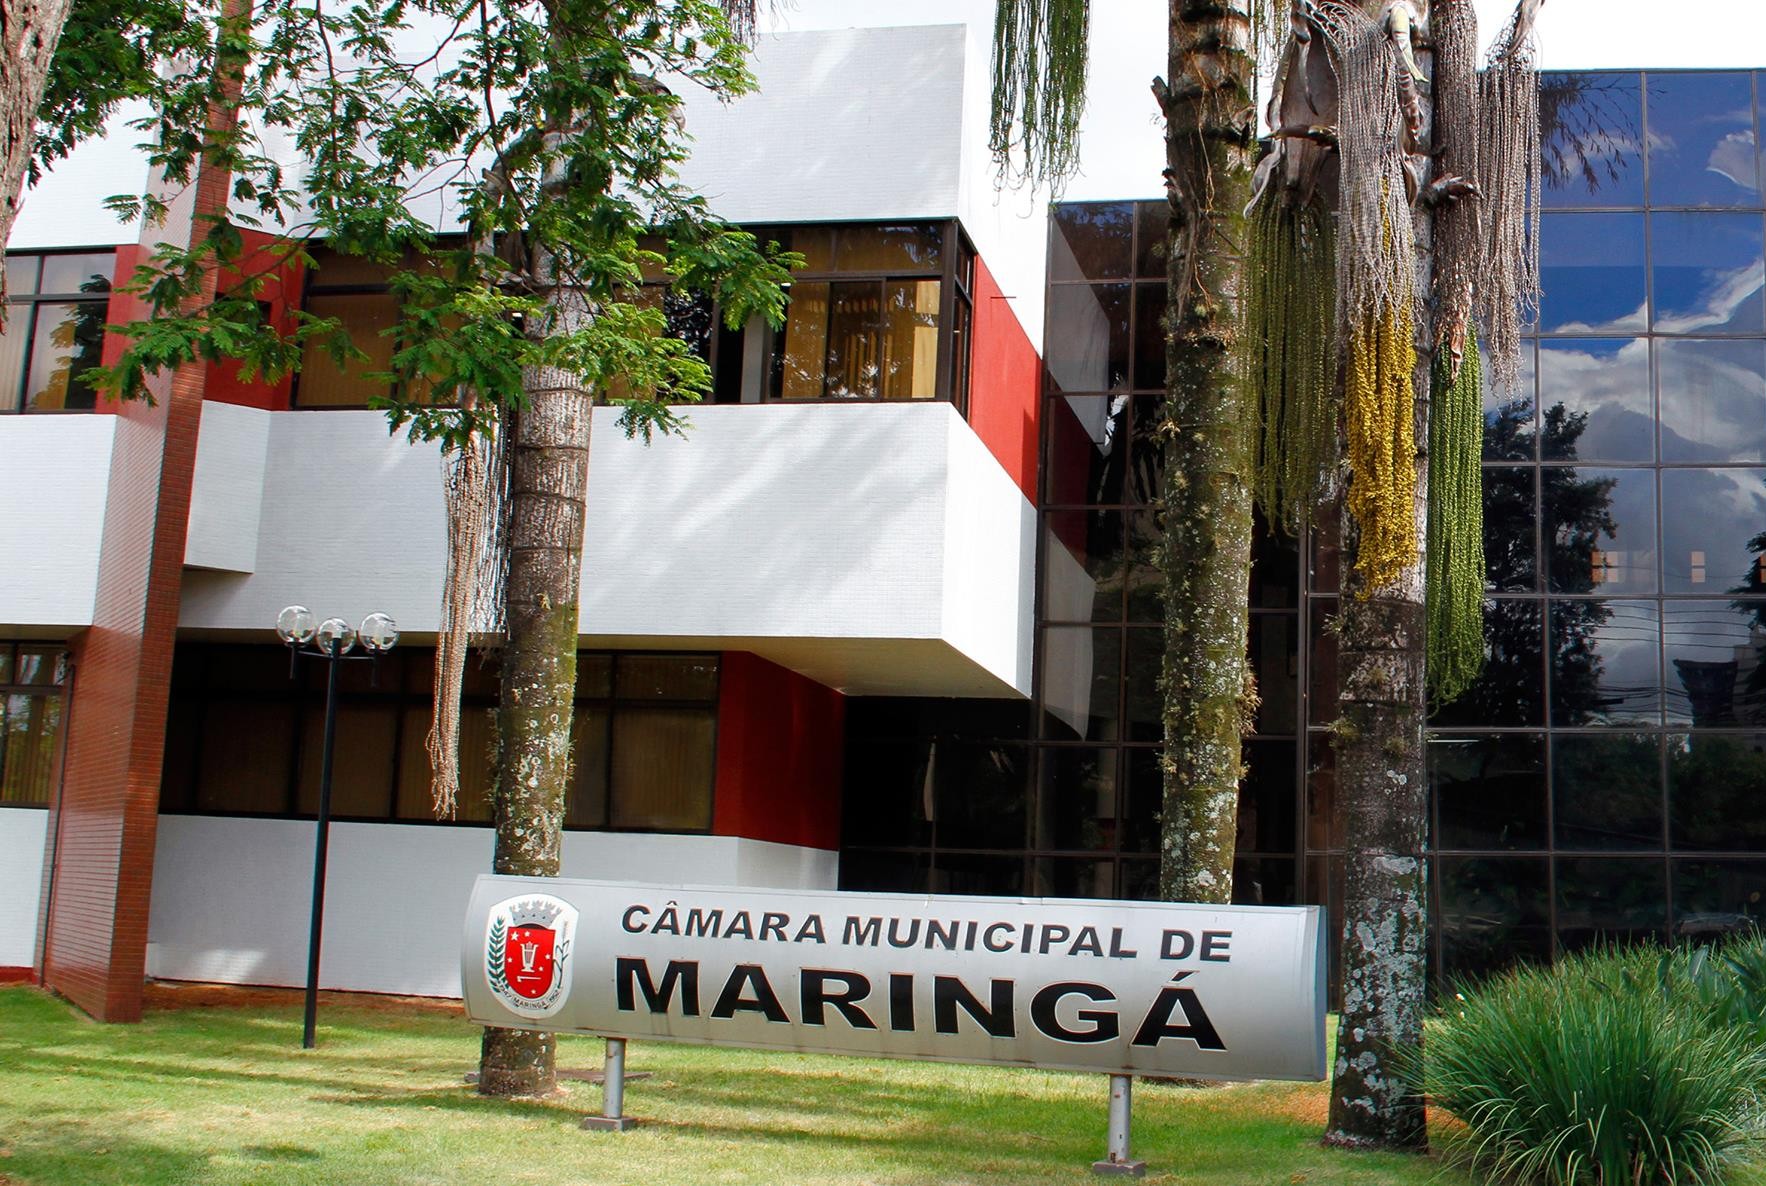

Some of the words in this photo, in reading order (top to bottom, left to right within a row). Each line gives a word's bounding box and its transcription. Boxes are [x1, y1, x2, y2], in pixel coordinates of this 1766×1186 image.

[621, 901, 827, 944] CÂMARA
[842, 915, 1137, 959] MUNICIPAL
[1160, 929, 1234, 963] DE
[615, 955, 1228, 1052] MARINGÁ
